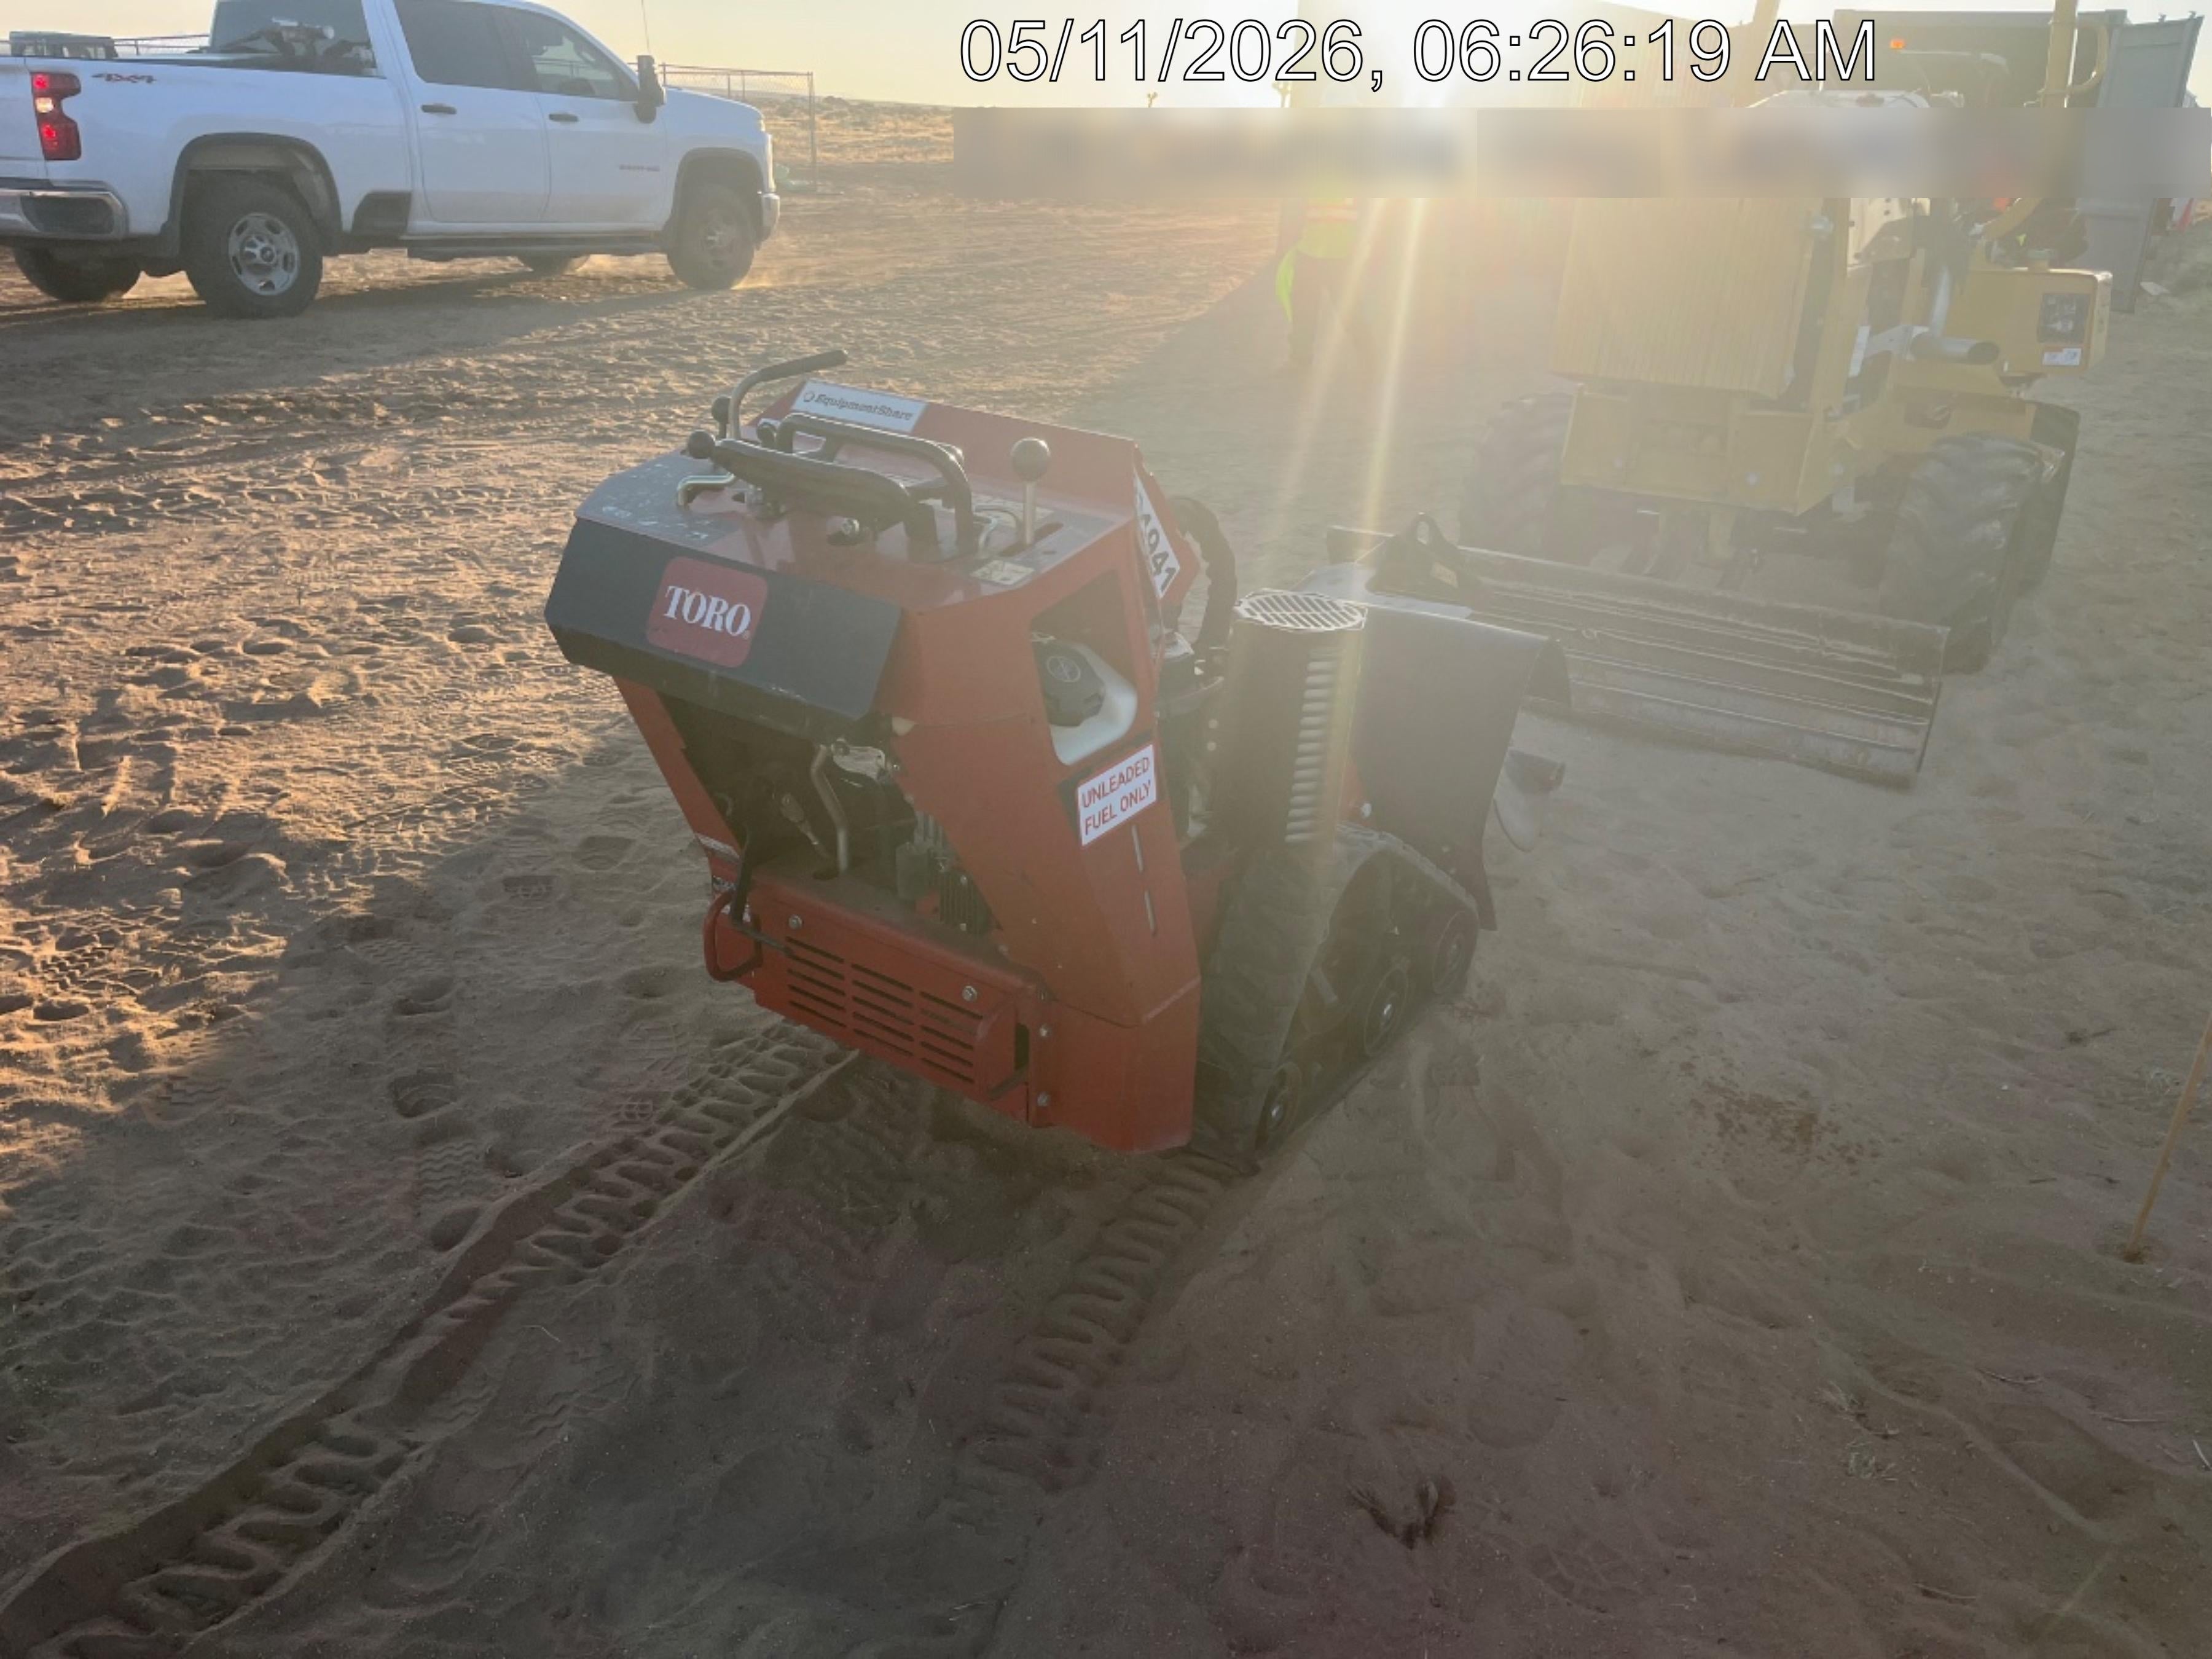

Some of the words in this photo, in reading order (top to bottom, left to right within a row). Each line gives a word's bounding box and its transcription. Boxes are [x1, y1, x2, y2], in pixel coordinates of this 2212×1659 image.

[815, 393, 914, 421] EquipmentShare
[663, 585, 751, 637] TORO
[1082, 756, 1150, 809] UNLEADED
[1084, 803, 1118, 836] FUEL
[1120, 779, 1151, 812] ONLY
